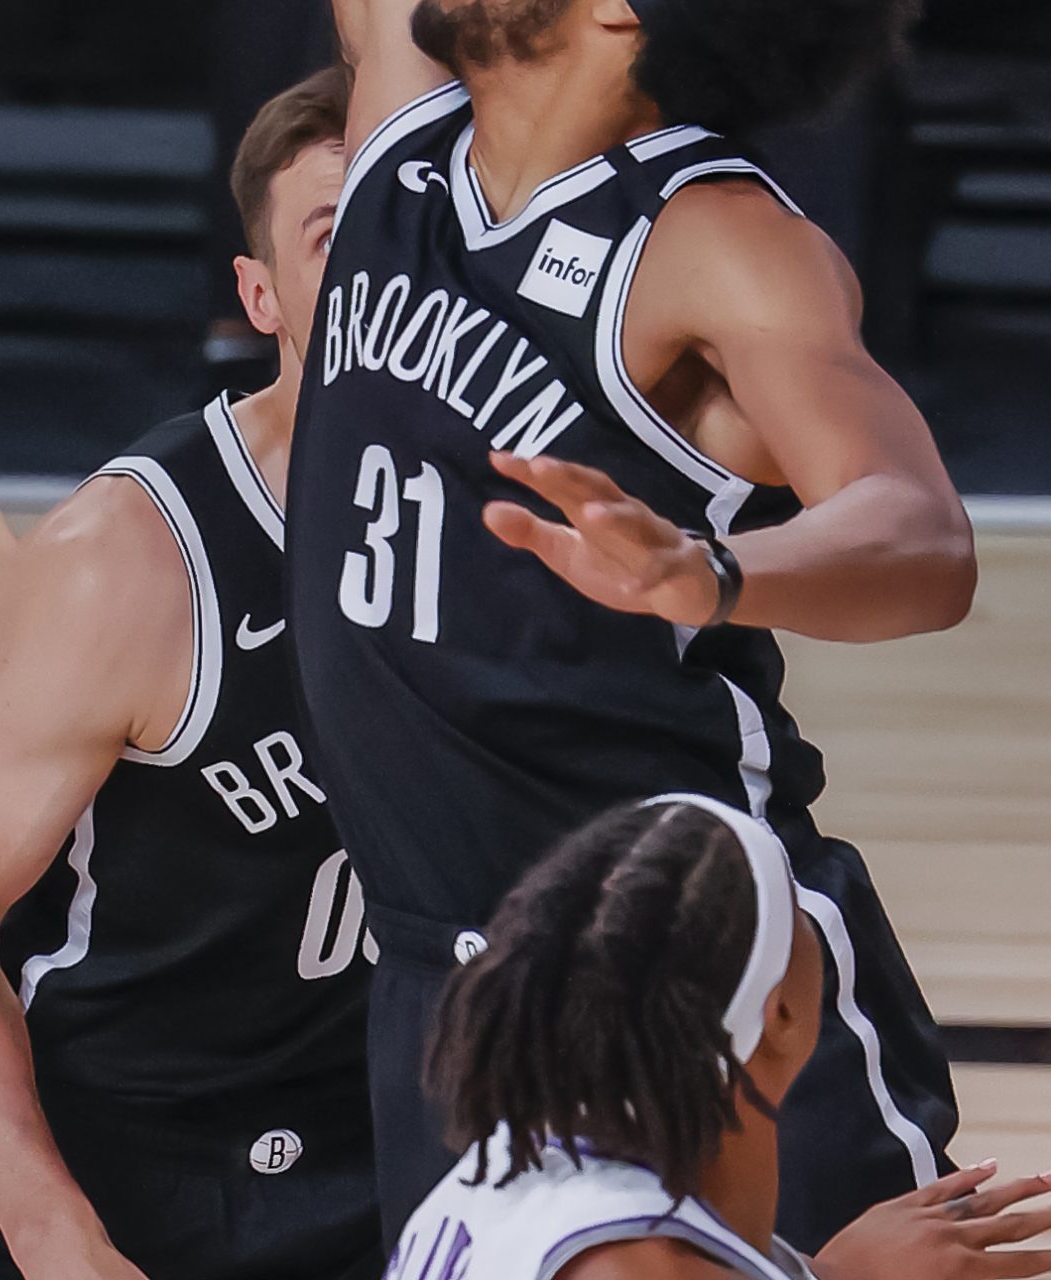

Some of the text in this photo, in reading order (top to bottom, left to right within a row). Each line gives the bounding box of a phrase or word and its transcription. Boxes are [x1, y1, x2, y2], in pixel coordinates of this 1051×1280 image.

[537, 247, 597, 288] infor
[323, 270, 585, 460] BROOKLYN
[338, 444, 446, 644] 31
